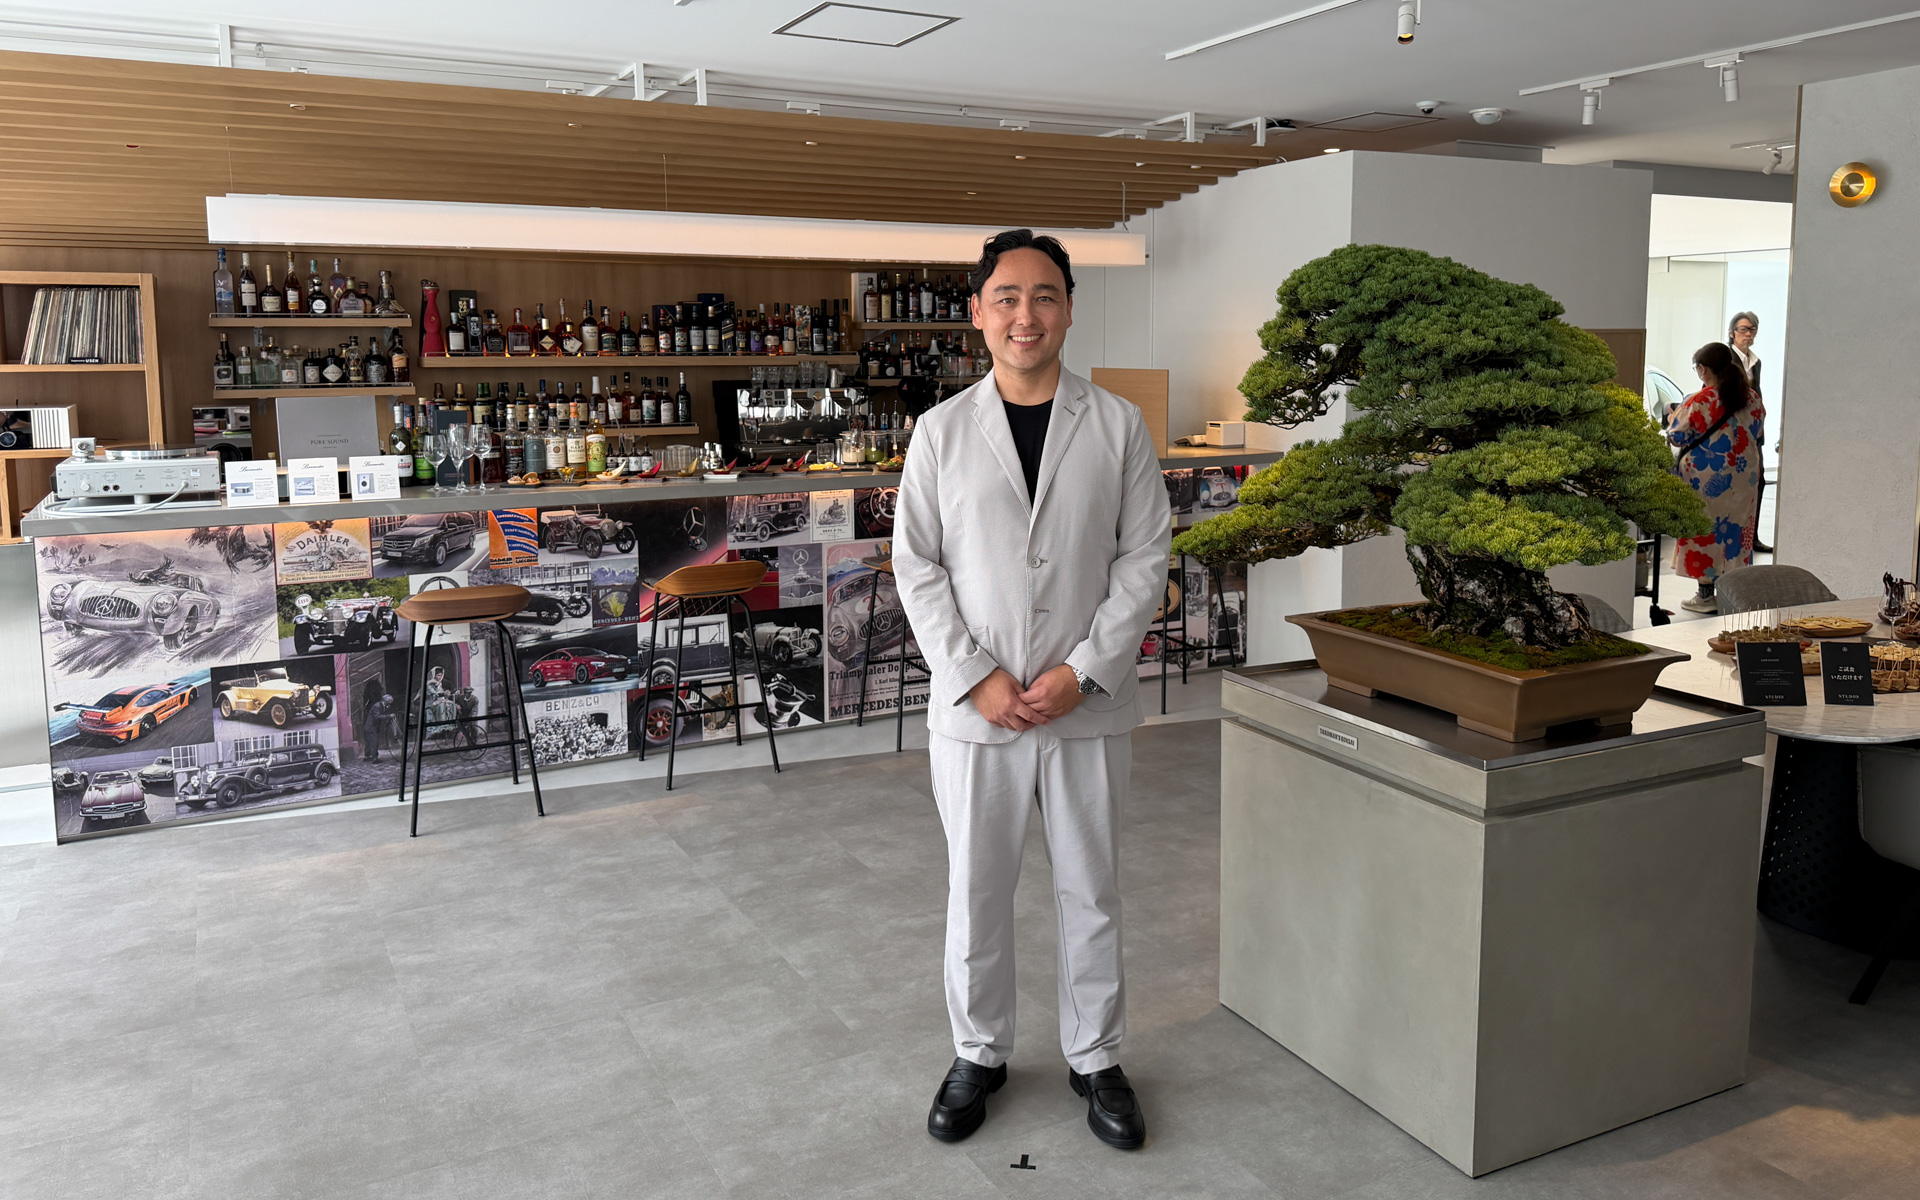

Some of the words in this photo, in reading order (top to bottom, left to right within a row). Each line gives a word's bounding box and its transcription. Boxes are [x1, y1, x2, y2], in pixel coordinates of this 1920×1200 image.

[296, 534, 350, 550] DAIMLER
[593, 616, 640, 624] MERCEDES-BENZ
[829, 666, 886, 680] Triumpaler
